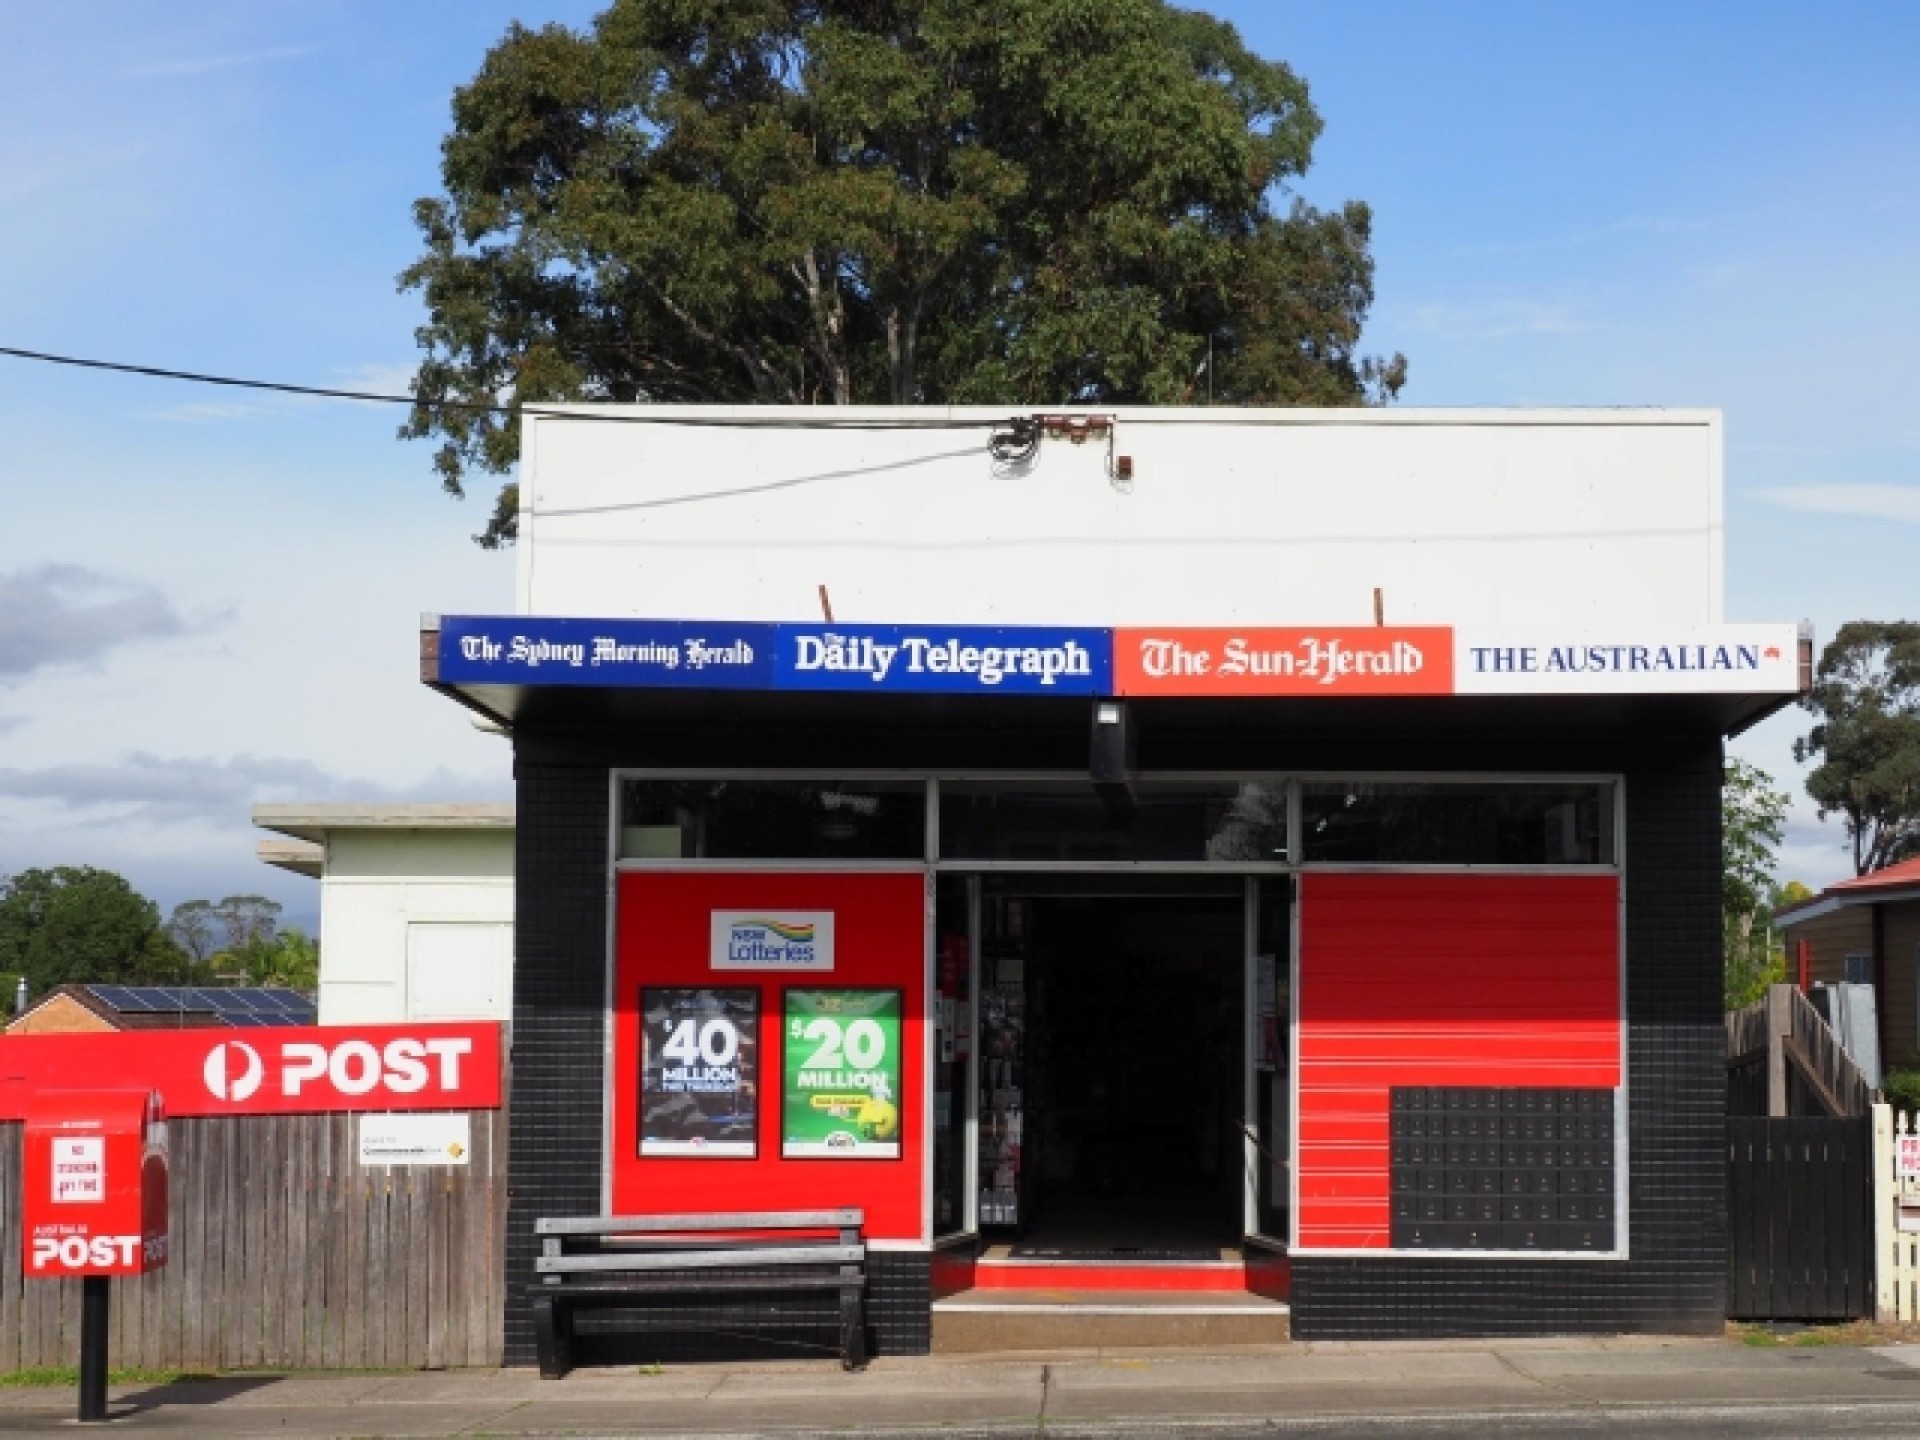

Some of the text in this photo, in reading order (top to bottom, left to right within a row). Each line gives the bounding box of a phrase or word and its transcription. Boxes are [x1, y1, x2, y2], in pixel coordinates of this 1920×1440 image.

[460, 635, 754, 669] The Sydney Morning Herald
[794, 634, 1092, 685] Daily Telegraph
[1140, 637, 1424, 685] The Sun-Herald
[1470, 645, 1759, 673] THE AUSTRALIAN
[728, 941, 815, 962] Lotteries
[791, 1017, 886, 1069] $20
[282, 1038, 472, 1095] POST
[797, 1070, 889, 1090] MILLION
[33, 1234, 141, 1268] POST
